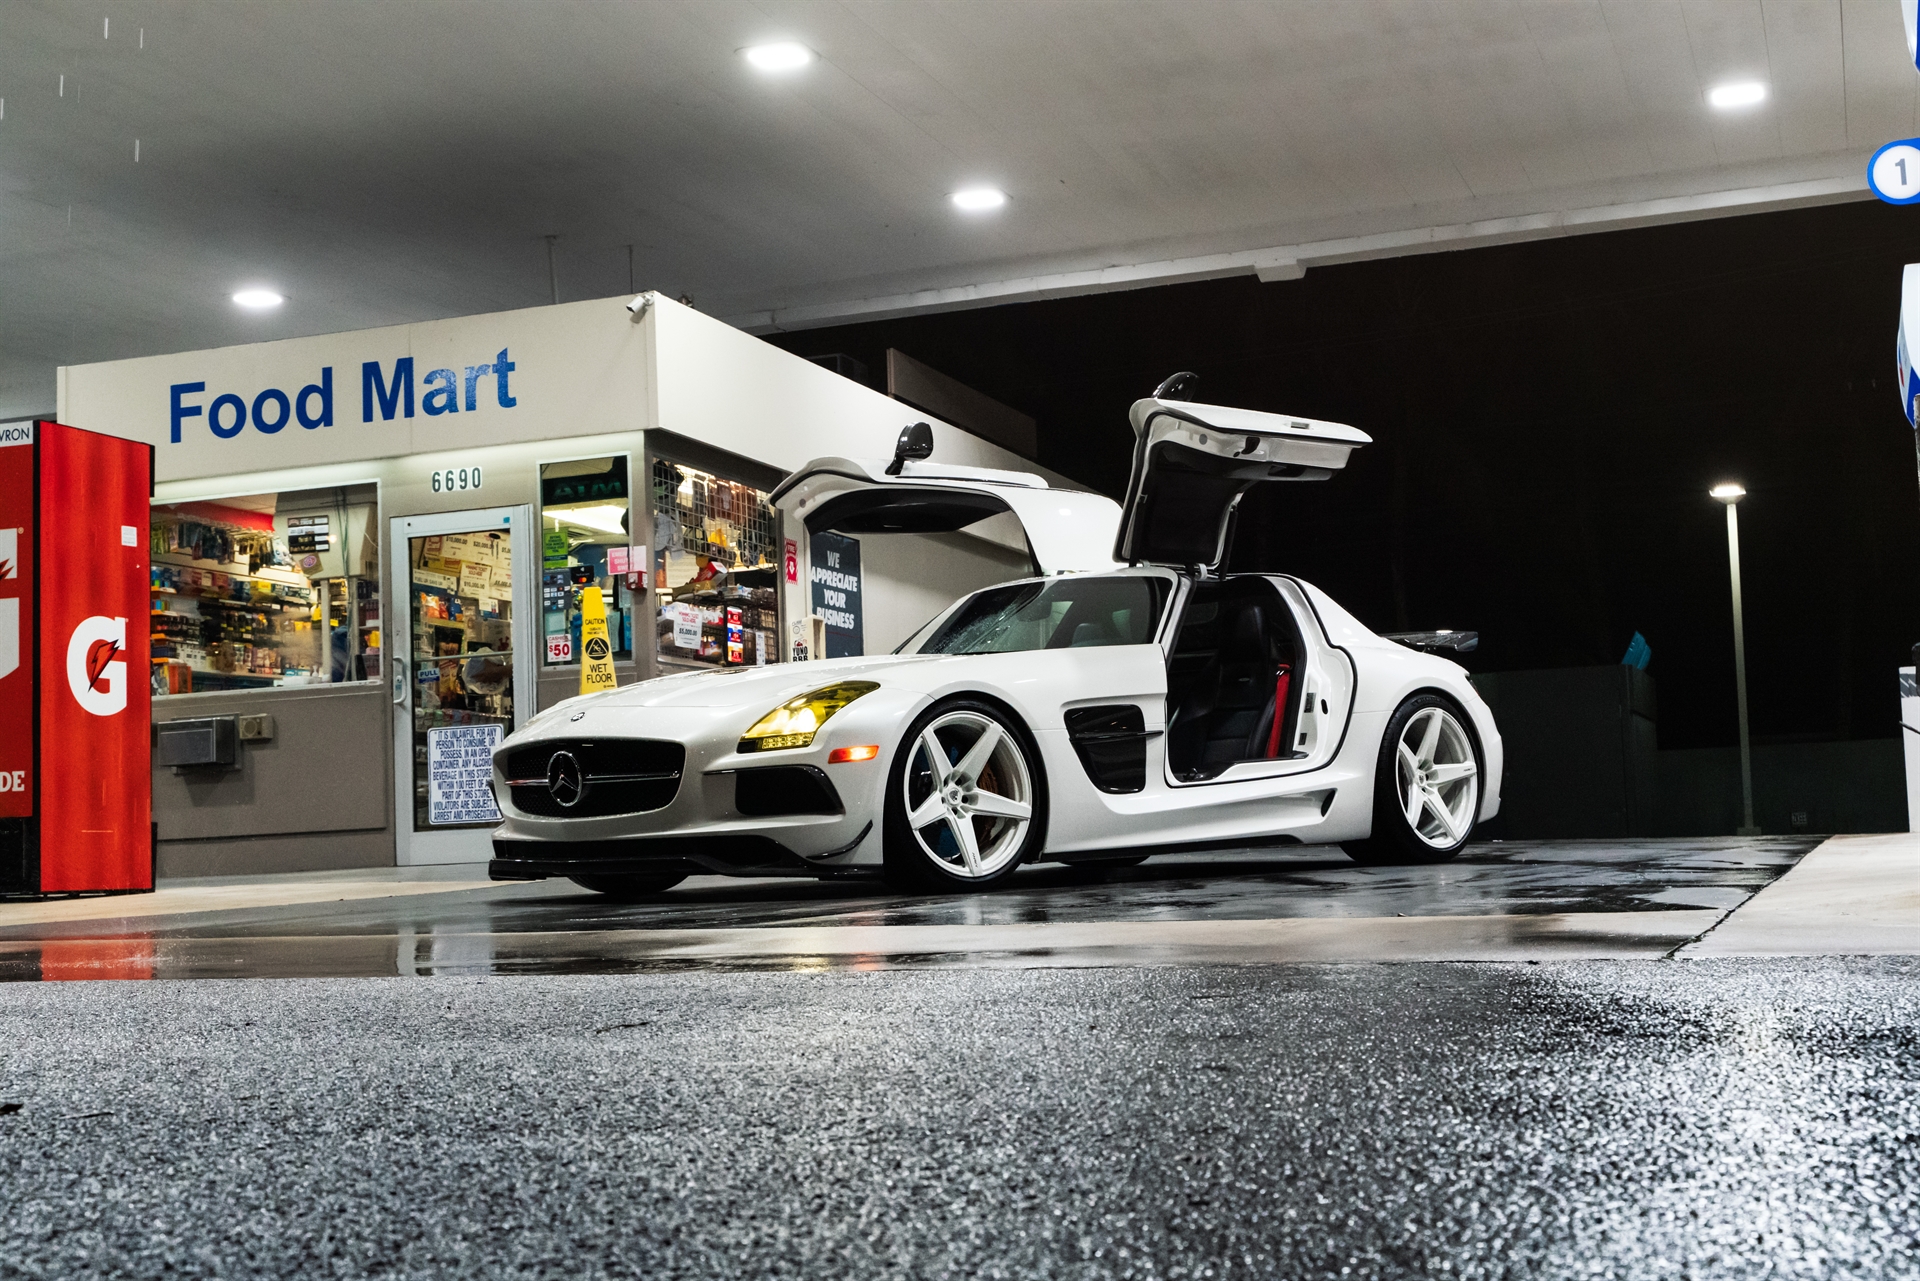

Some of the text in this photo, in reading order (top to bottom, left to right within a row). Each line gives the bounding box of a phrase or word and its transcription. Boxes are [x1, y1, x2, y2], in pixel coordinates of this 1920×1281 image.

[1895, 158, 1907, 186] 1
[170, 348, 516, 443] Food Mart
[432, 467, 480, 492] 6690
[554, 482, 622, 498] ATM
[827, 551, 840, 568] WE
[810, 566, 858, 592] APPRECIATE
[824, 589, 846, 608] YOUR
[817, 607, 854, 629] BUSINESS
[549, 644, 569, 656] $50
[66, 616, 127, 716] G
[590, 664, 607, 672] WET
[420, 669, 438, 678] PULL
[587, 673, 612, 683] FLOOR
[438, 728, 496, 739] IT IS UNLAWFUL FOR ANY
[436, 740, 454, 749] PERSON
[456, 740, 461, 748] TO
[489, 738, 495, 746] OR
[464, 749, 469, 758] IN
[471, 749, 477, 757] AN
[478, 748, 491, 756] OPEN
[462, 759, 471, 768] ANY
[473, 758, 492, 767] ALCOHO
[433, 769, 491, 780] BEVERAGE IN THIS STORE
[0, 771, 24, 792] DE
[438, 782, 454, 790] WITHIN
[456, 781, 464, 789] 100
[466, 780, 476, 788] FEET
[478, 779, 484, 788] OF
[442, 791, 454, 800] PART
[455, 790, 461, 799] OF
[463, 790, 473, 799] THIS
[434, 801, 459, 810] VIOLATORS
[461, 800, 470, 809] ARE
[471, 800, 492, 808] SUBJECT
[434, 809, 497, 820] ARREST AND PROSECUTION
